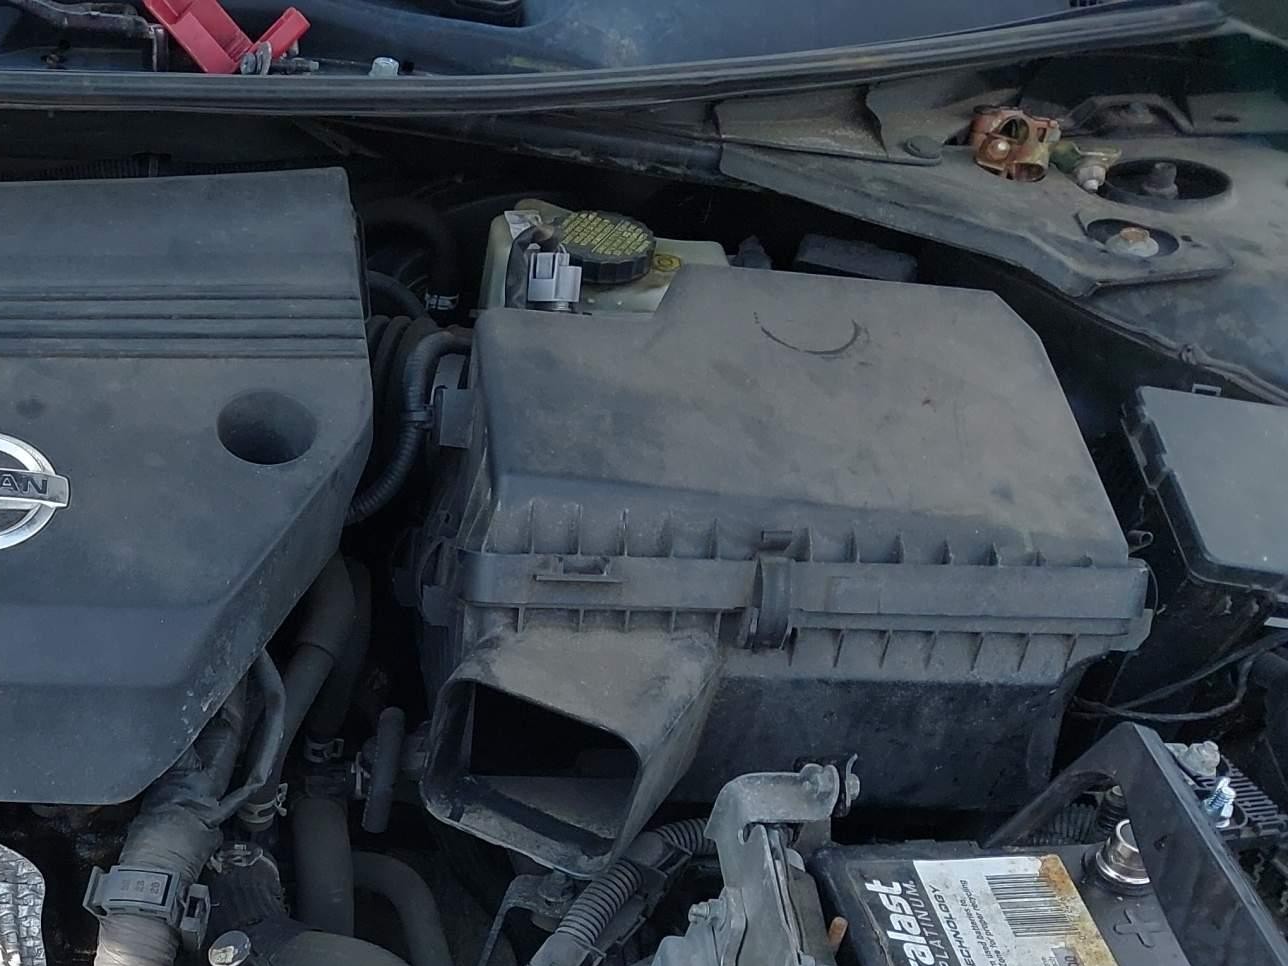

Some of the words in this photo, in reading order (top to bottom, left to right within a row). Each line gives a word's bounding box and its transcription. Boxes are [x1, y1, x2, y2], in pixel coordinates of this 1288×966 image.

[958, 880, 981, 910] recycling
[963, 908, 984, 940] batteries
[974, 913, 993, 936] proper
[986, 937, 999, 947] for
